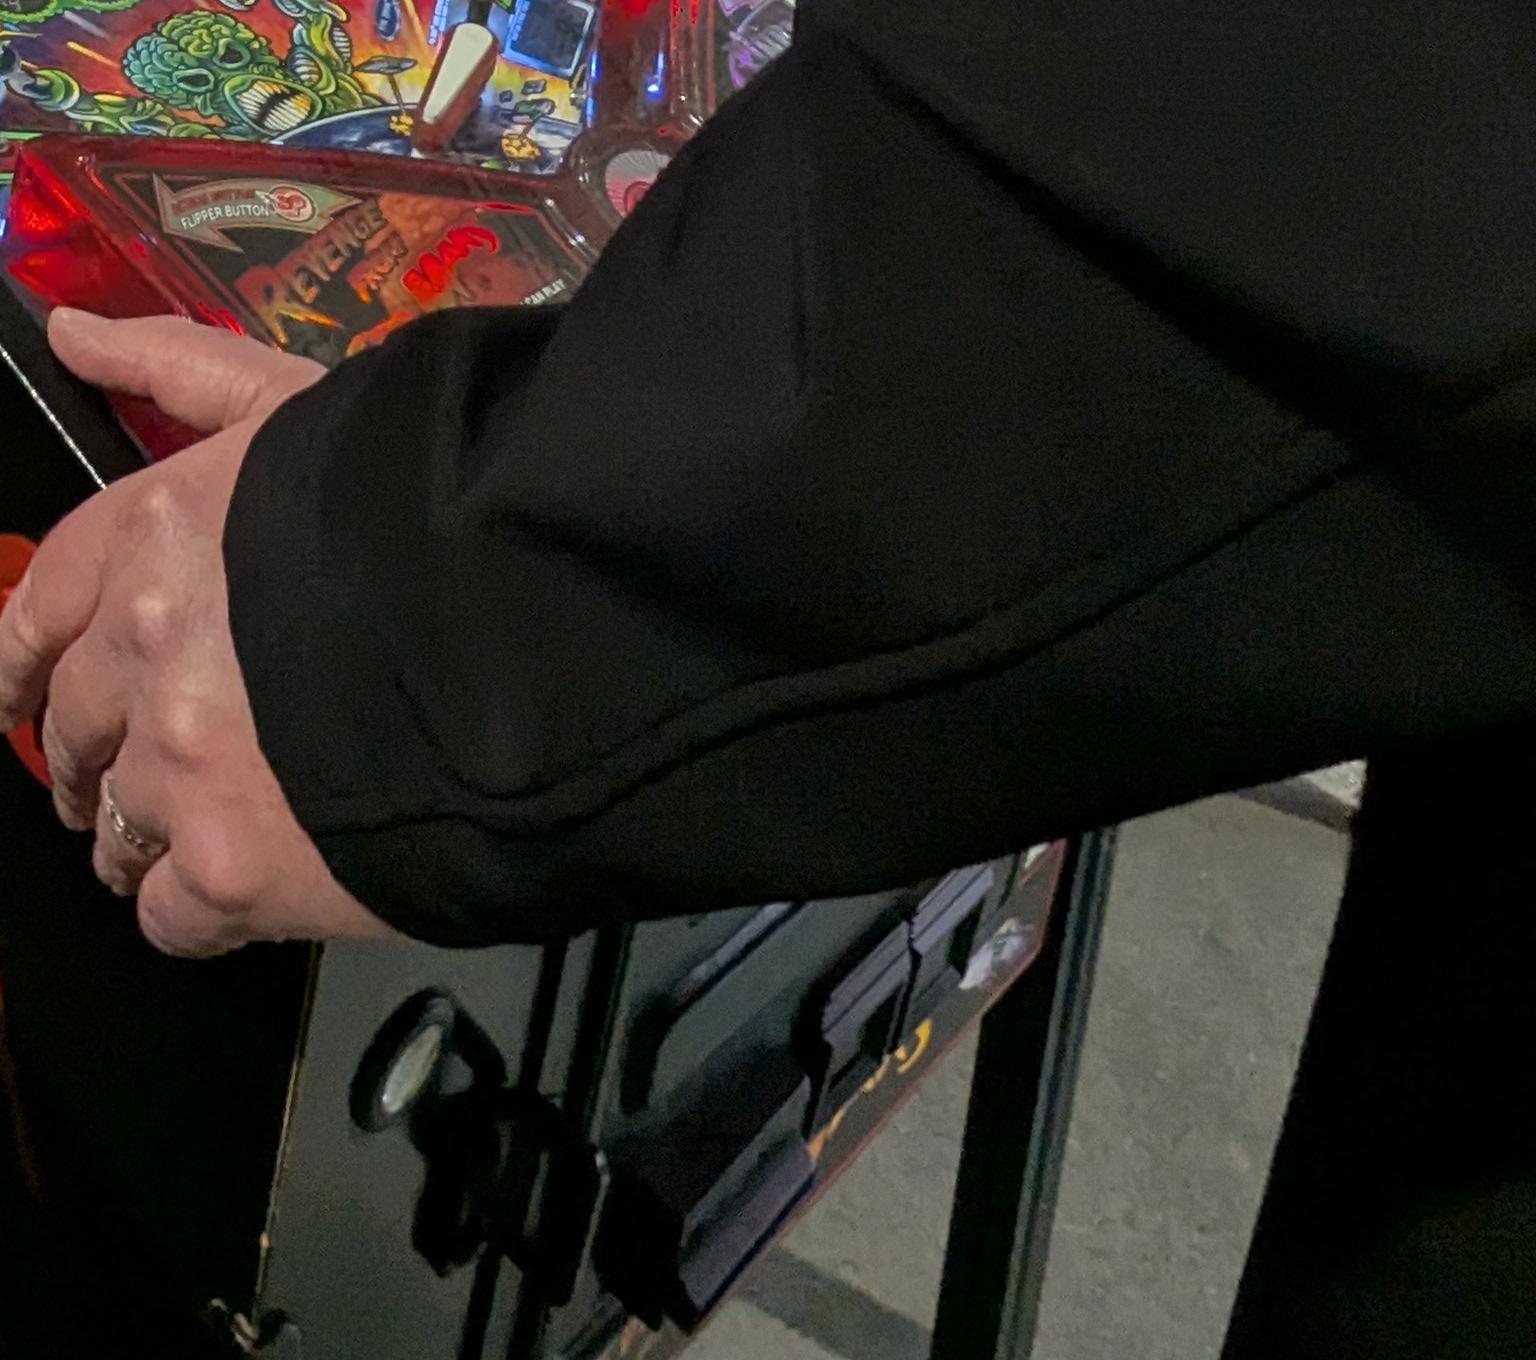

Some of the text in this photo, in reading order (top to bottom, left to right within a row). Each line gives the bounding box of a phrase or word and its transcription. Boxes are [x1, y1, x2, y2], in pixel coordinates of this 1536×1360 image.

[180, 202, 270, 230] FLIPPER BUTTON
[541, 278, 566, 298] PLAY
